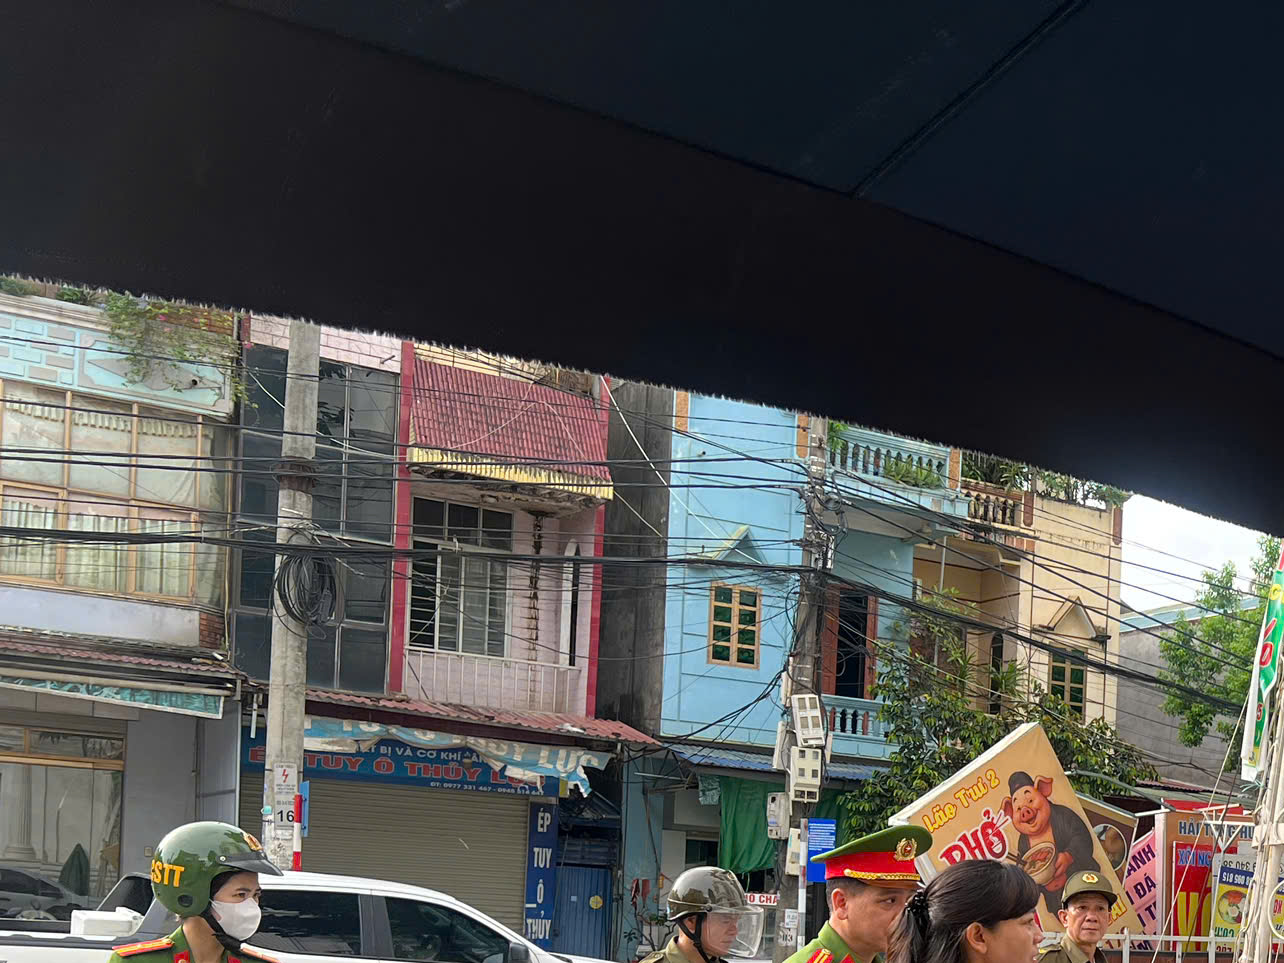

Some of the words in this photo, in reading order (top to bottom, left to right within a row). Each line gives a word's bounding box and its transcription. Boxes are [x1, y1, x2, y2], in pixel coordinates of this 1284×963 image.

[303, 752, 365, 772] TUY
[373, 756, 395, 775] Ô
[922, 803, 957, 833] Lão
[985, 769, 1000, 789] 2
[276, 810, 294, 823] 16
[537, 807, 551, 832] ÉP
[533, 847, 552, 869] TUY
[537, 879, 544, 904] Ô
